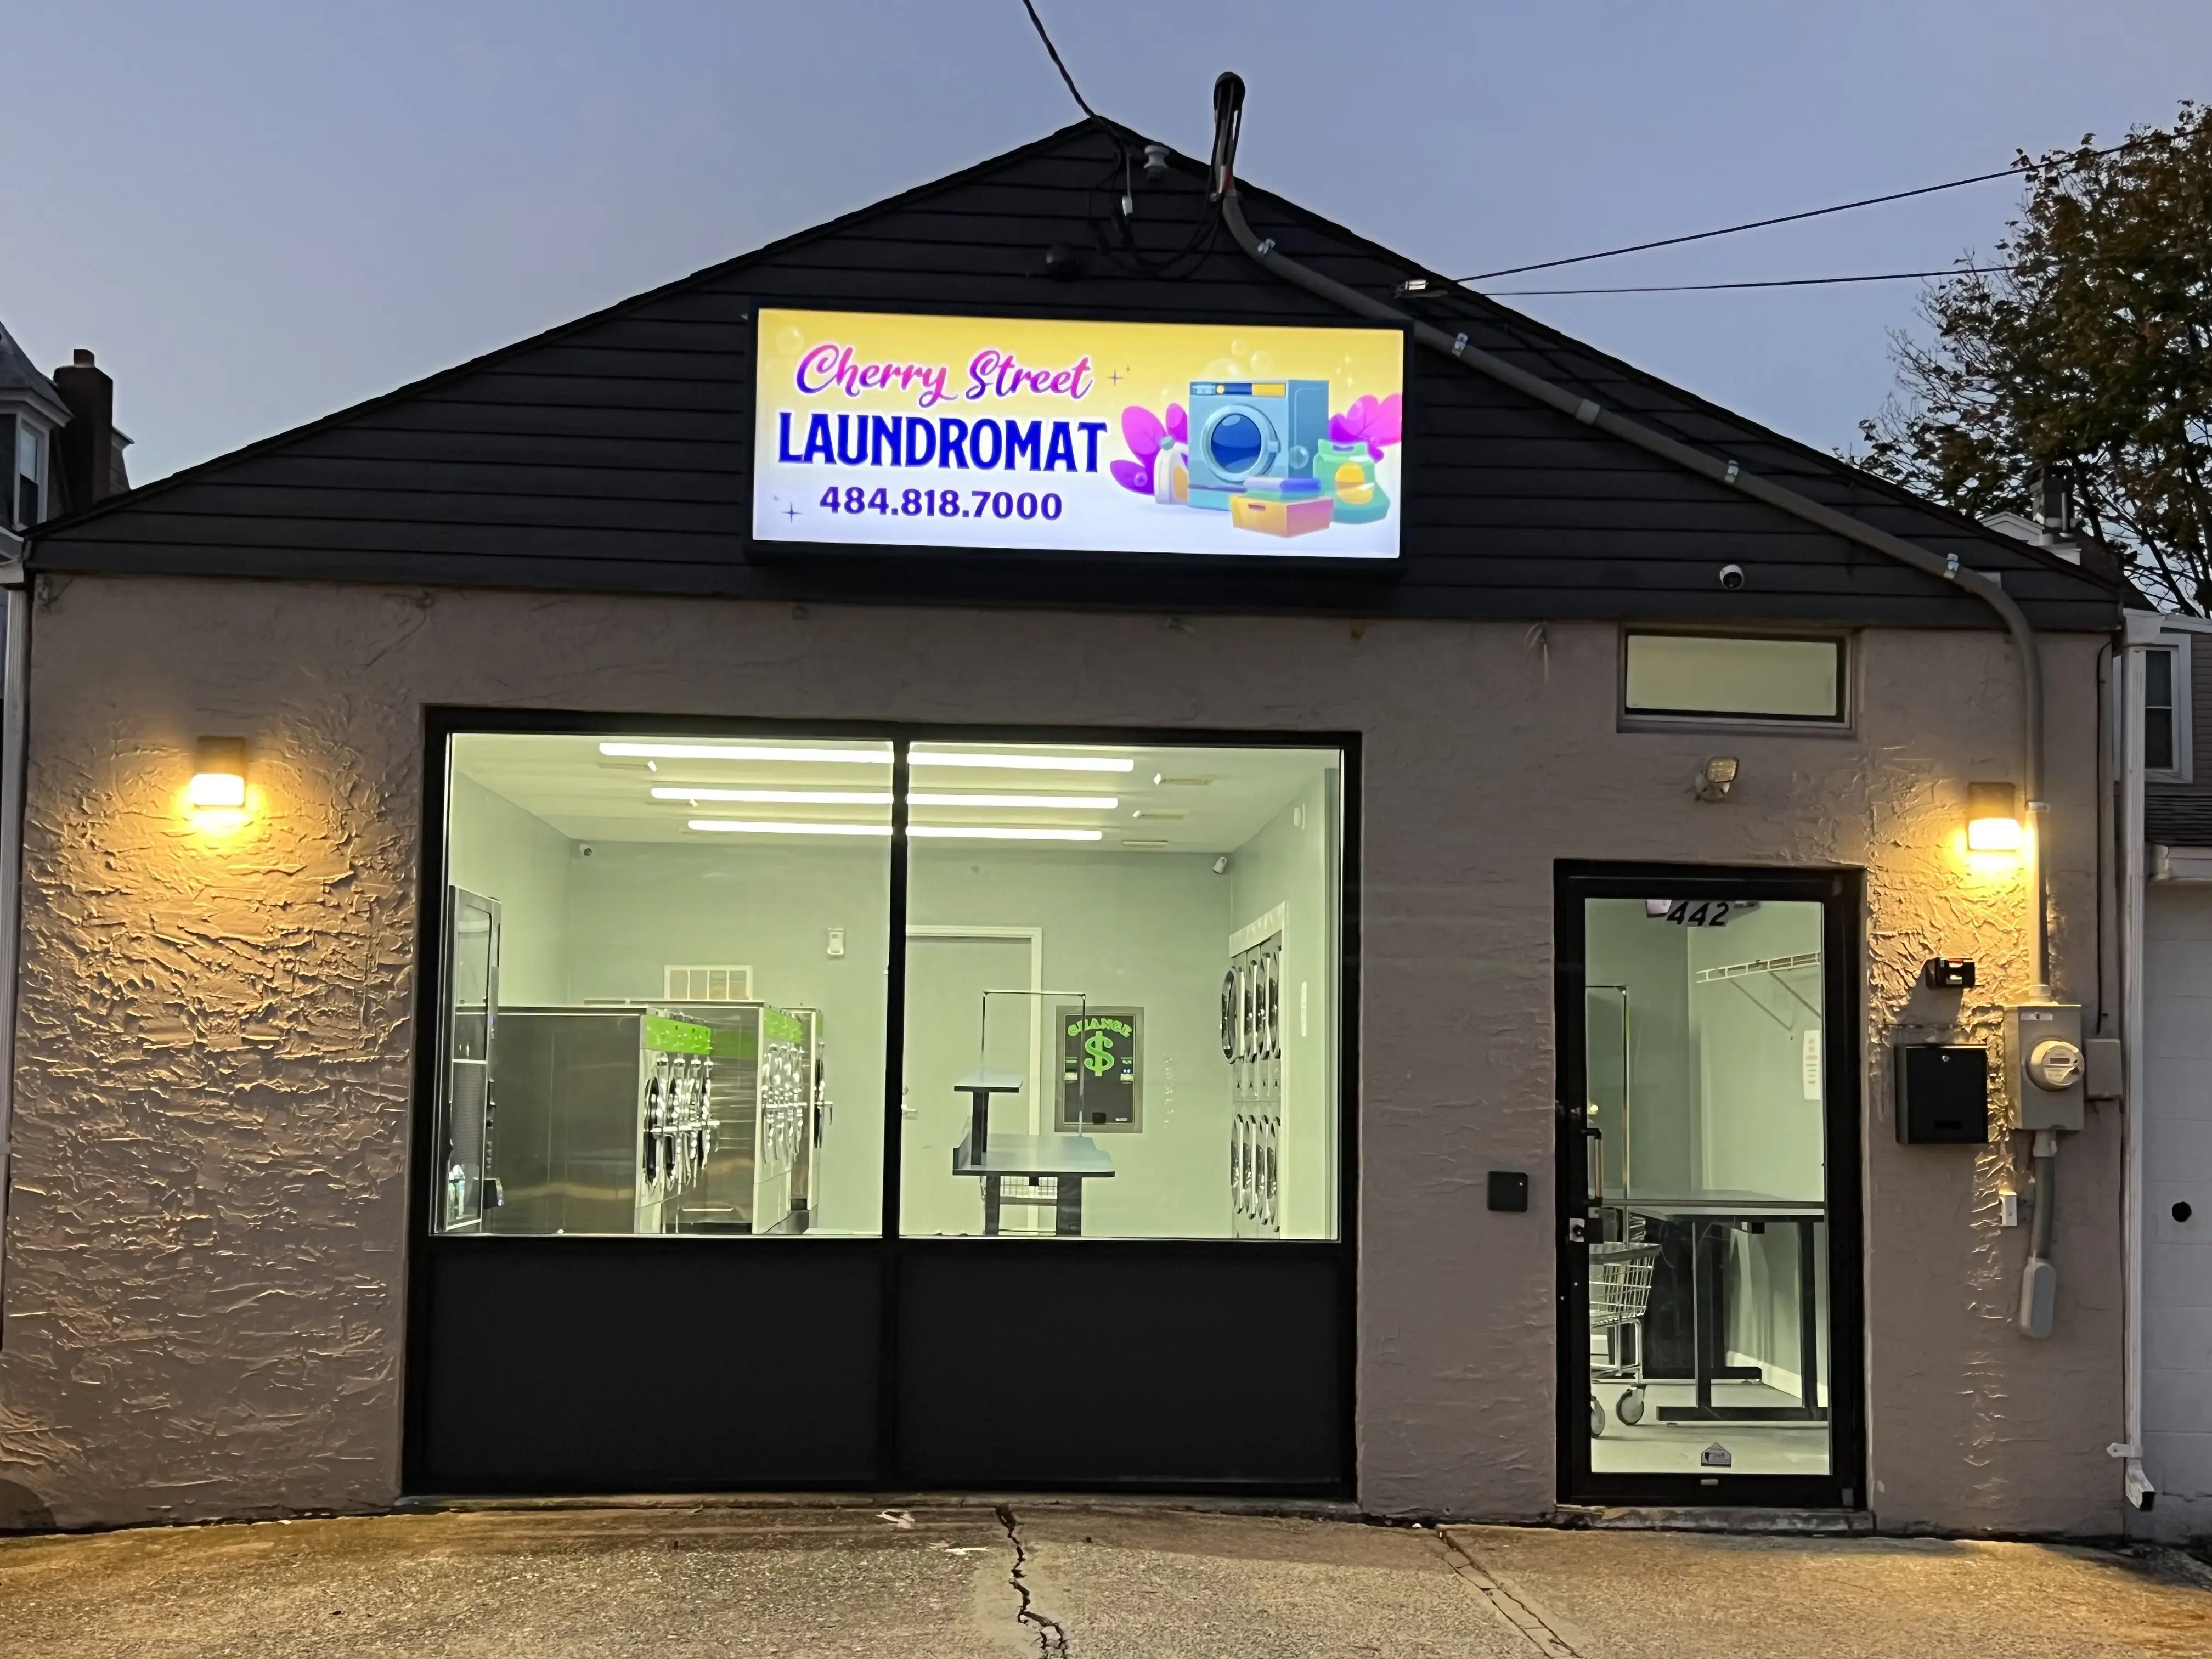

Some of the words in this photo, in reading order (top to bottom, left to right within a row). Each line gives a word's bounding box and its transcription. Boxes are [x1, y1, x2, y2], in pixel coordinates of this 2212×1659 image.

[796, 344, 959, 408] Cherry
[964, 349, 1094, 400] Street
[778, 411, 1108, 473] LAUNDROMAT
[819, 486, 1063, 521] 484.818.7000
[1666, 901, 1729, 927] 442
